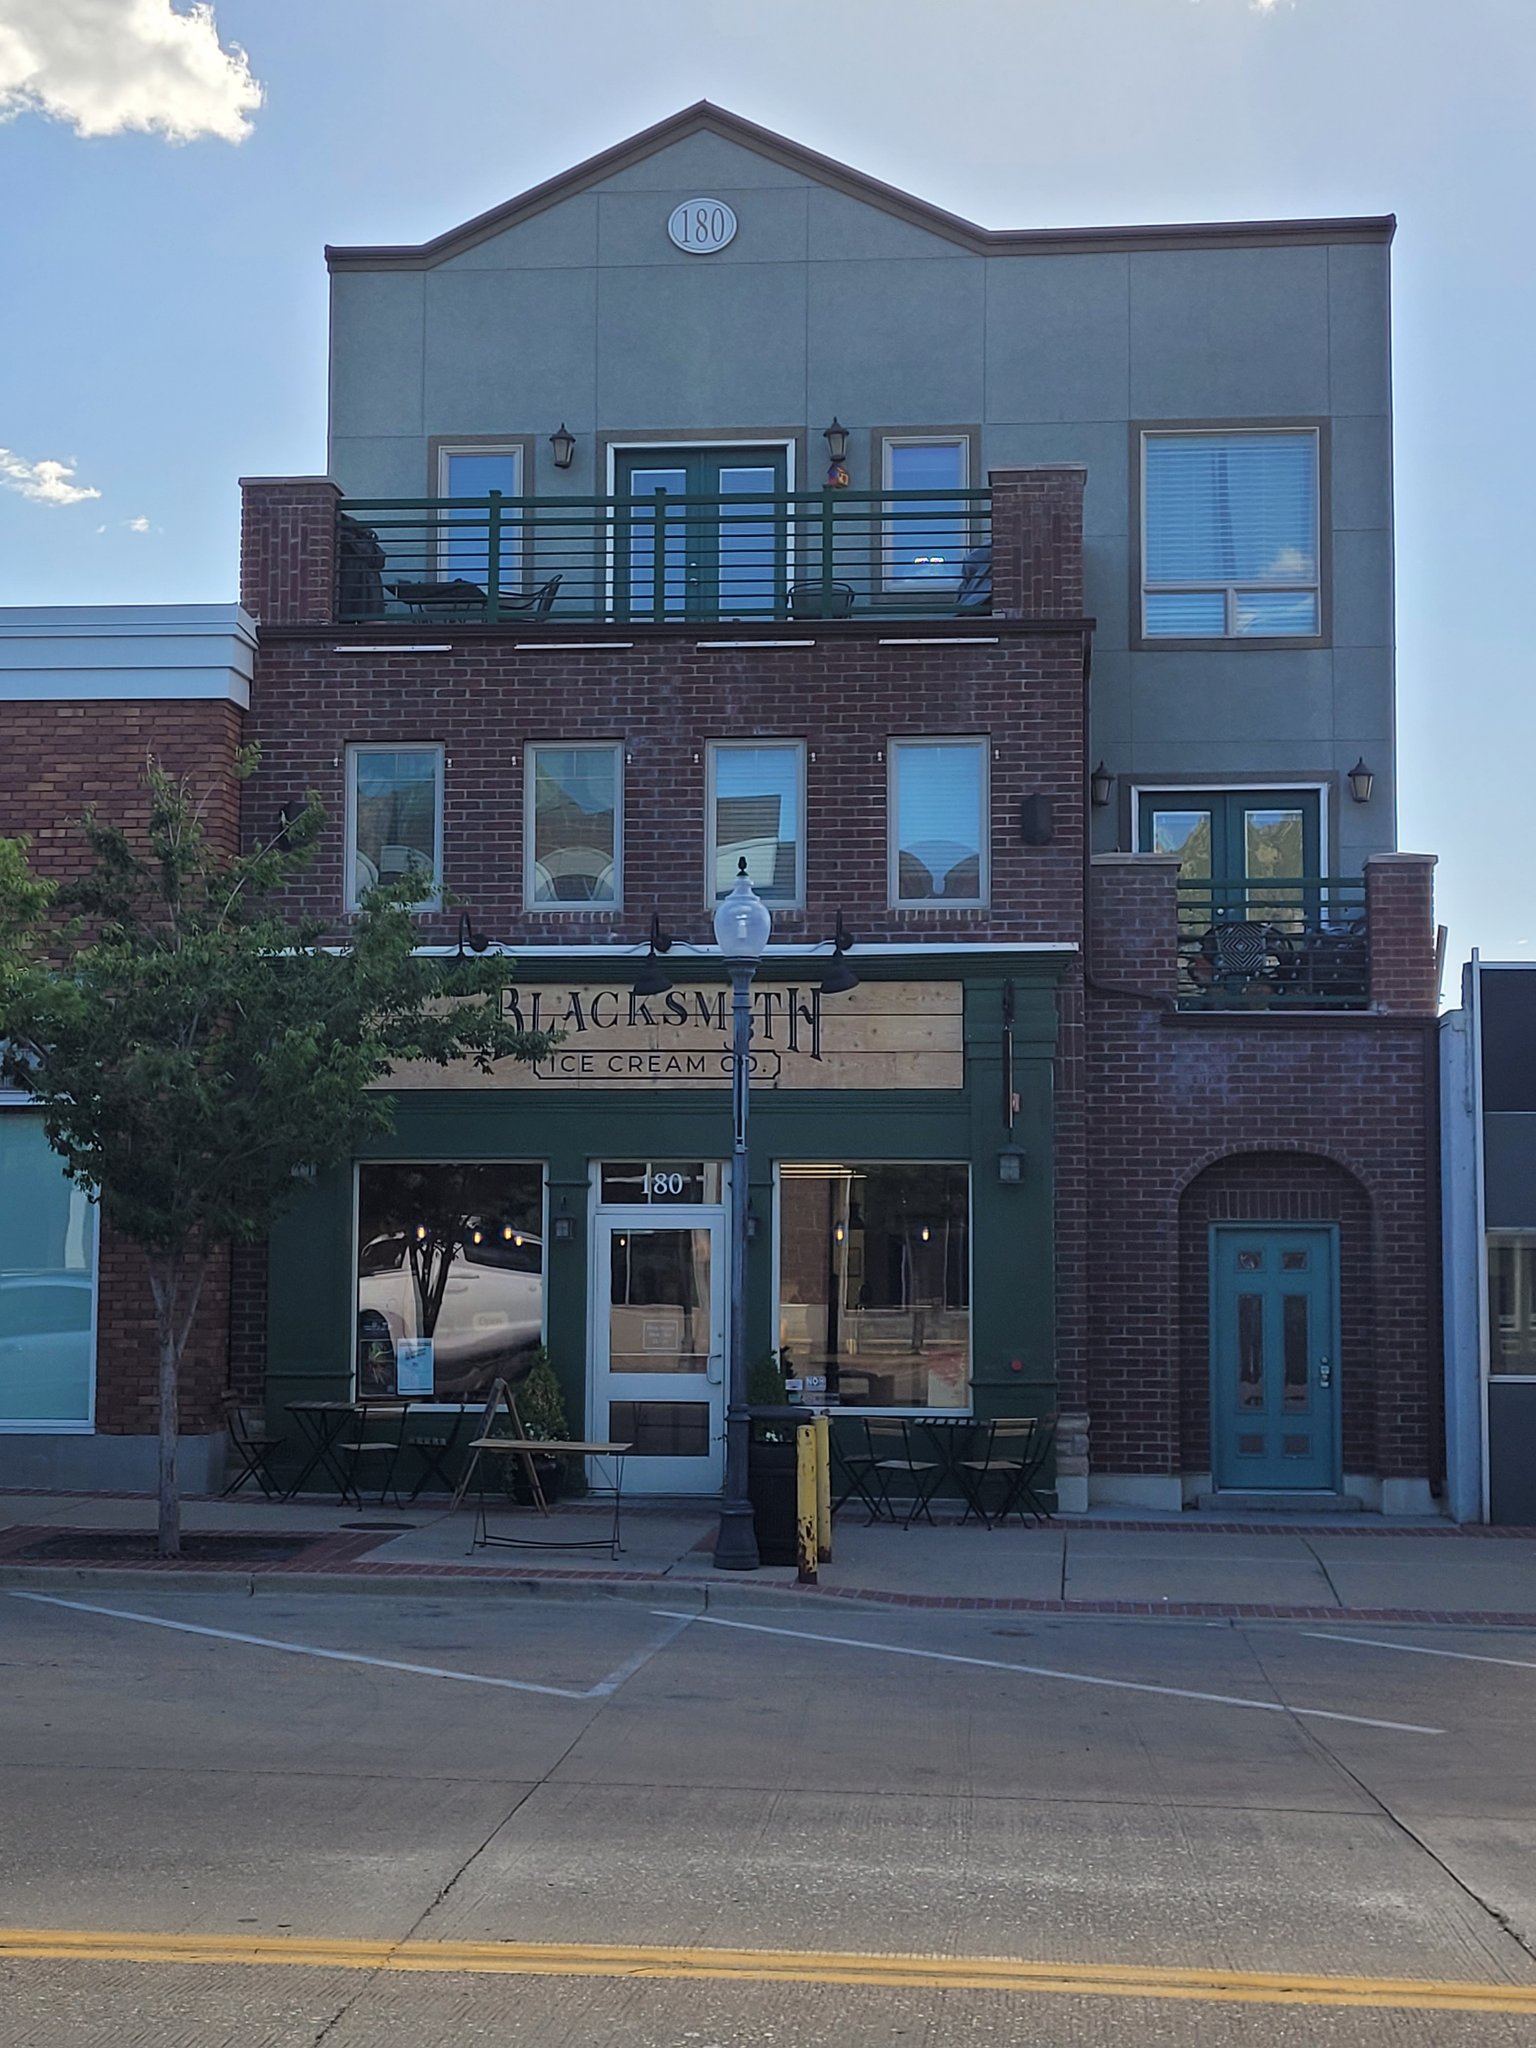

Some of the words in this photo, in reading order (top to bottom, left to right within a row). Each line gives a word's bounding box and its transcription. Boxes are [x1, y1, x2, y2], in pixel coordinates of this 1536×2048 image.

[682, 208, 724, 243] 180
[494, 987, 822, 1061] BLACKSMTH
[551, 1055, 594, 1073] ICE
[608, 1055, 705, 1073] CREAM
[641, 1172, 683, 1195] 180
